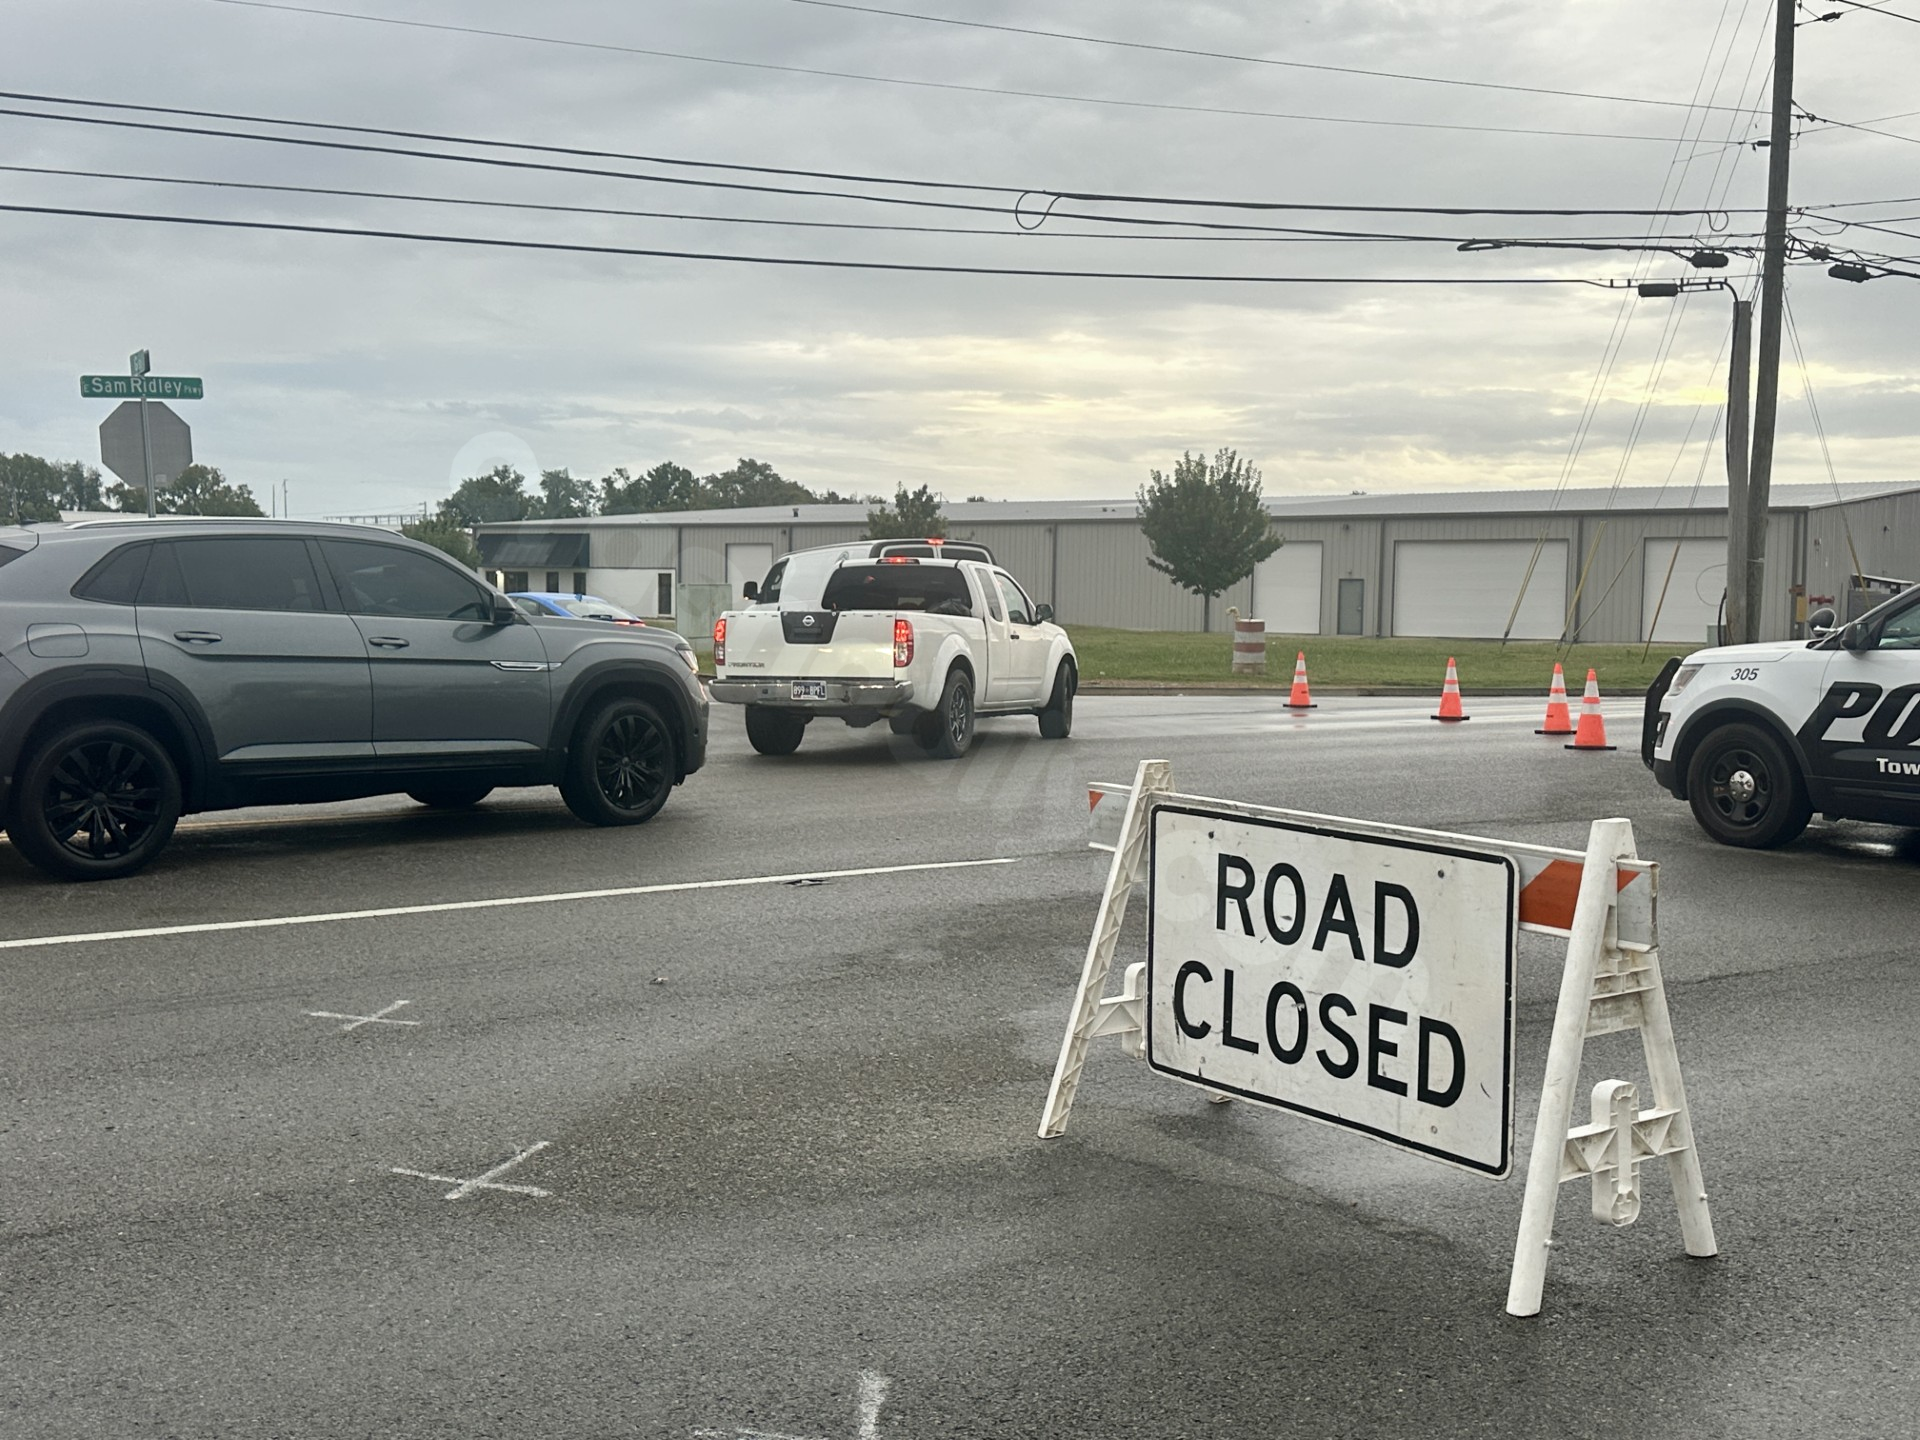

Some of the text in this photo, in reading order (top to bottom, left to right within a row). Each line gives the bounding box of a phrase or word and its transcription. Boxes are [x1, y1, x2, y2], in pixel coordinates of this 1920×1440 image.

[92, 377, 127, 393] Sam
[131, 377, 182, 397] Ridley
[1730, 667, 1760, 681] 305
[1215, 852, 1420, 969] ROAD
[1173, 960, 1466, 1108] CLOSED
